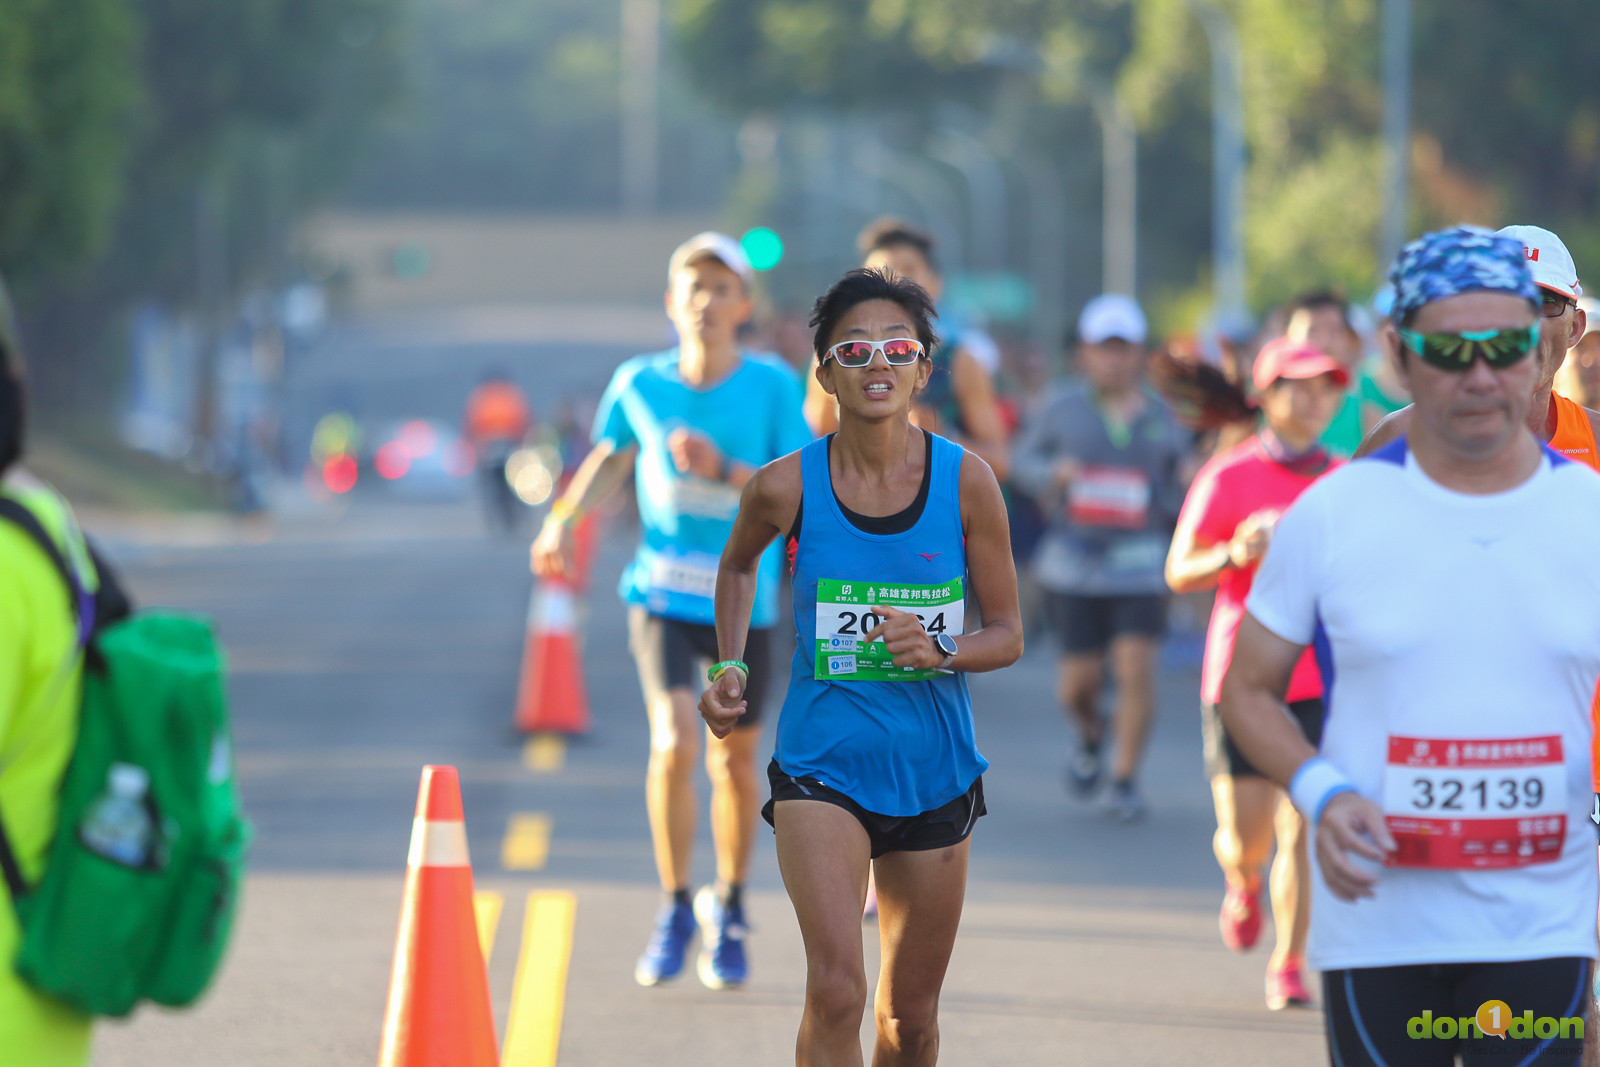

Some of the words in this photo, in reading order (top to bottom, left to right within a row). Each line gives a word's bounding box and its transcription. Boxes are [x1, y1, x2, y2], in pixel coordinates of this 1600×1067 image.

[879, 587, 950, 600] 高雄富邦馬拉松
[838, 611, 947, 634] 204
[1412, 778, 1545, 810] 32139
